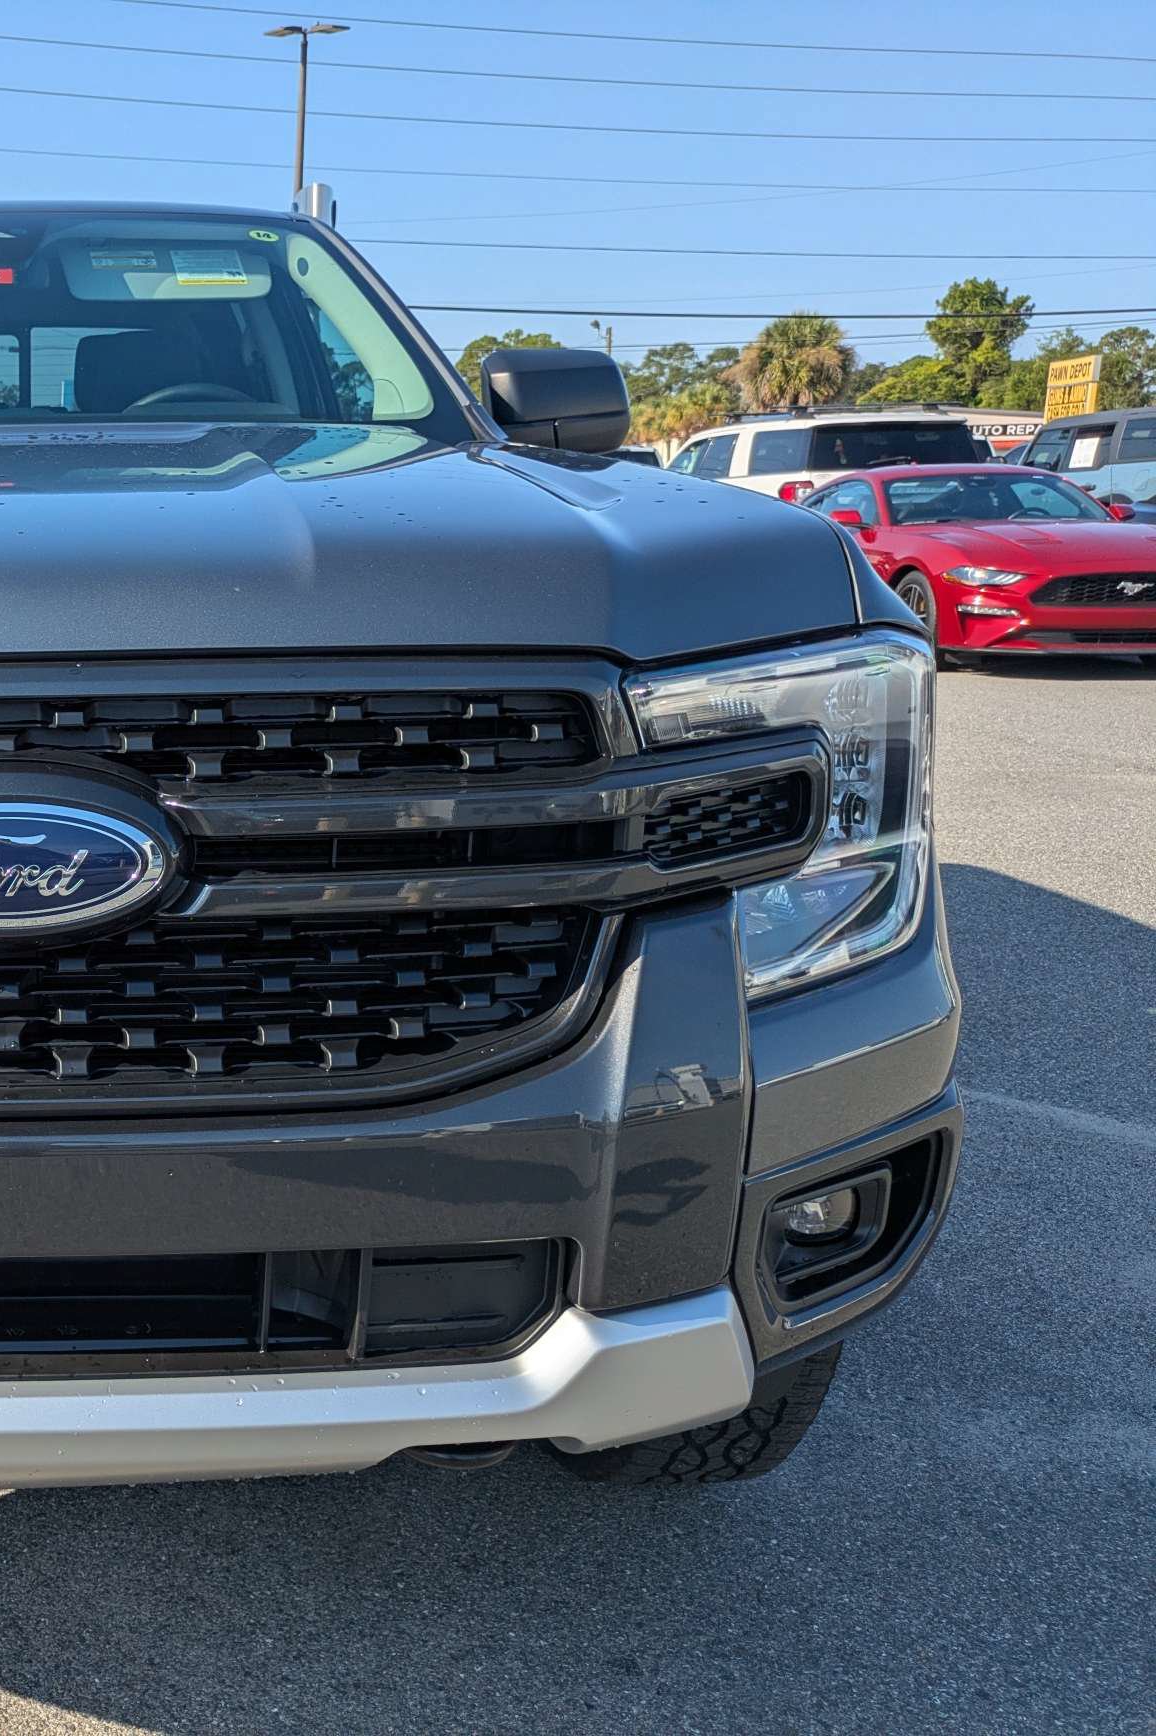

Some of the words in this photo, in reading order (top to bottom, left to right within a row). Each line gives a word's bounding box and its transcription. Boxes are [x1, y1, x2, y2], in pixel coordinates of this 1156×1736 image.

[1050, 365, 1069, 382] PAWN
[1069, 361, 1092, 379] DEPOT
[968, 425, 1003, 436] UTO
